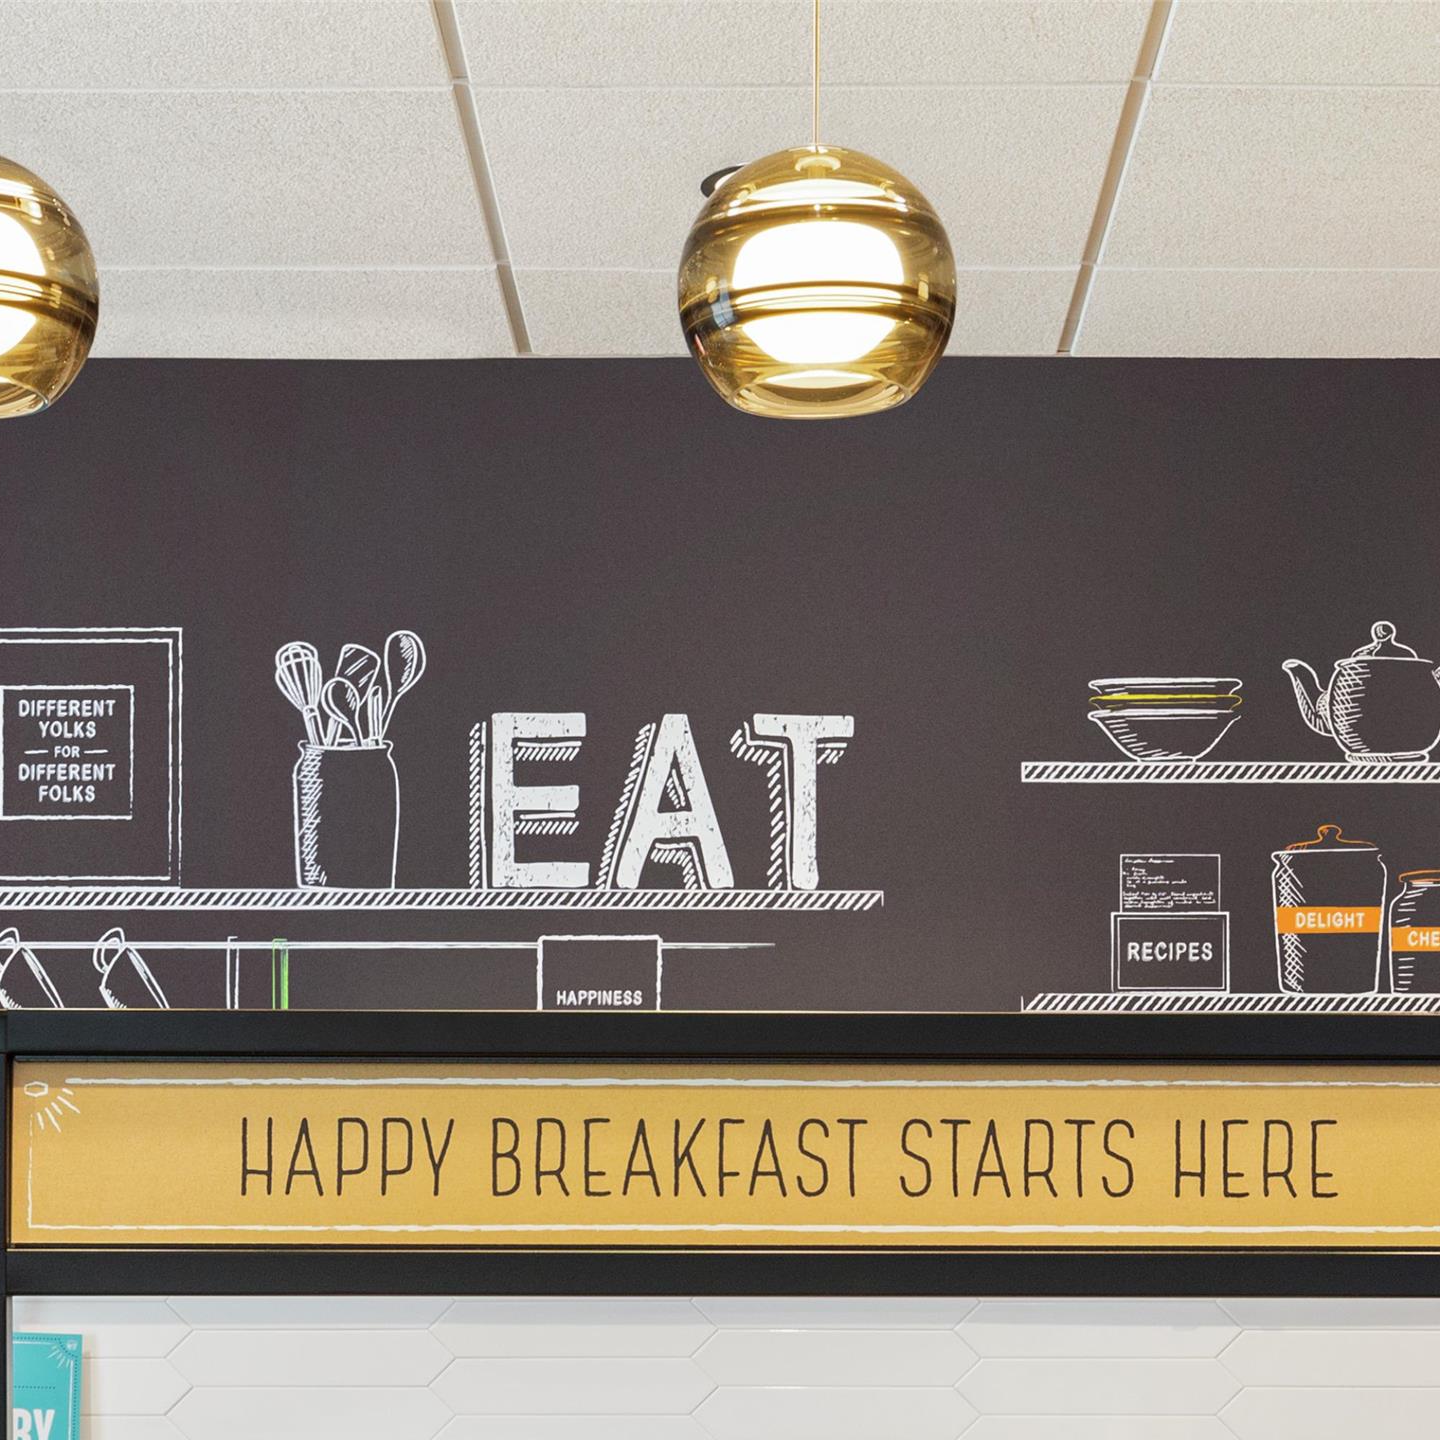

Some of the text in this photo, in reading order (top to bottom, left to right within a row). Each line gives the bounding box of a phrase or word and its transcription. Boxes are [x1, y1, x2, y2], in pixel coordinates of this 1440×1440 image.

[18, 699, 116, 717] DIFFERENT
[38, 720, 97, 738] YOLKS
[53, 745, 81, 758] FOR
[18, 763, 116, 781] DIFFERENT
[38, 784, 96, 802] FOLKS
[470, 711, 855, 891] EAT
[1294, 911, 1366, 929] DELIGHT
[1127, 941, 1214, 962] RECIPES
[556, 989, 643, 1006] HAPPINESS
[241, 1117, 1339, 1198] HAPPY BREAKFAST STARTS HERE
